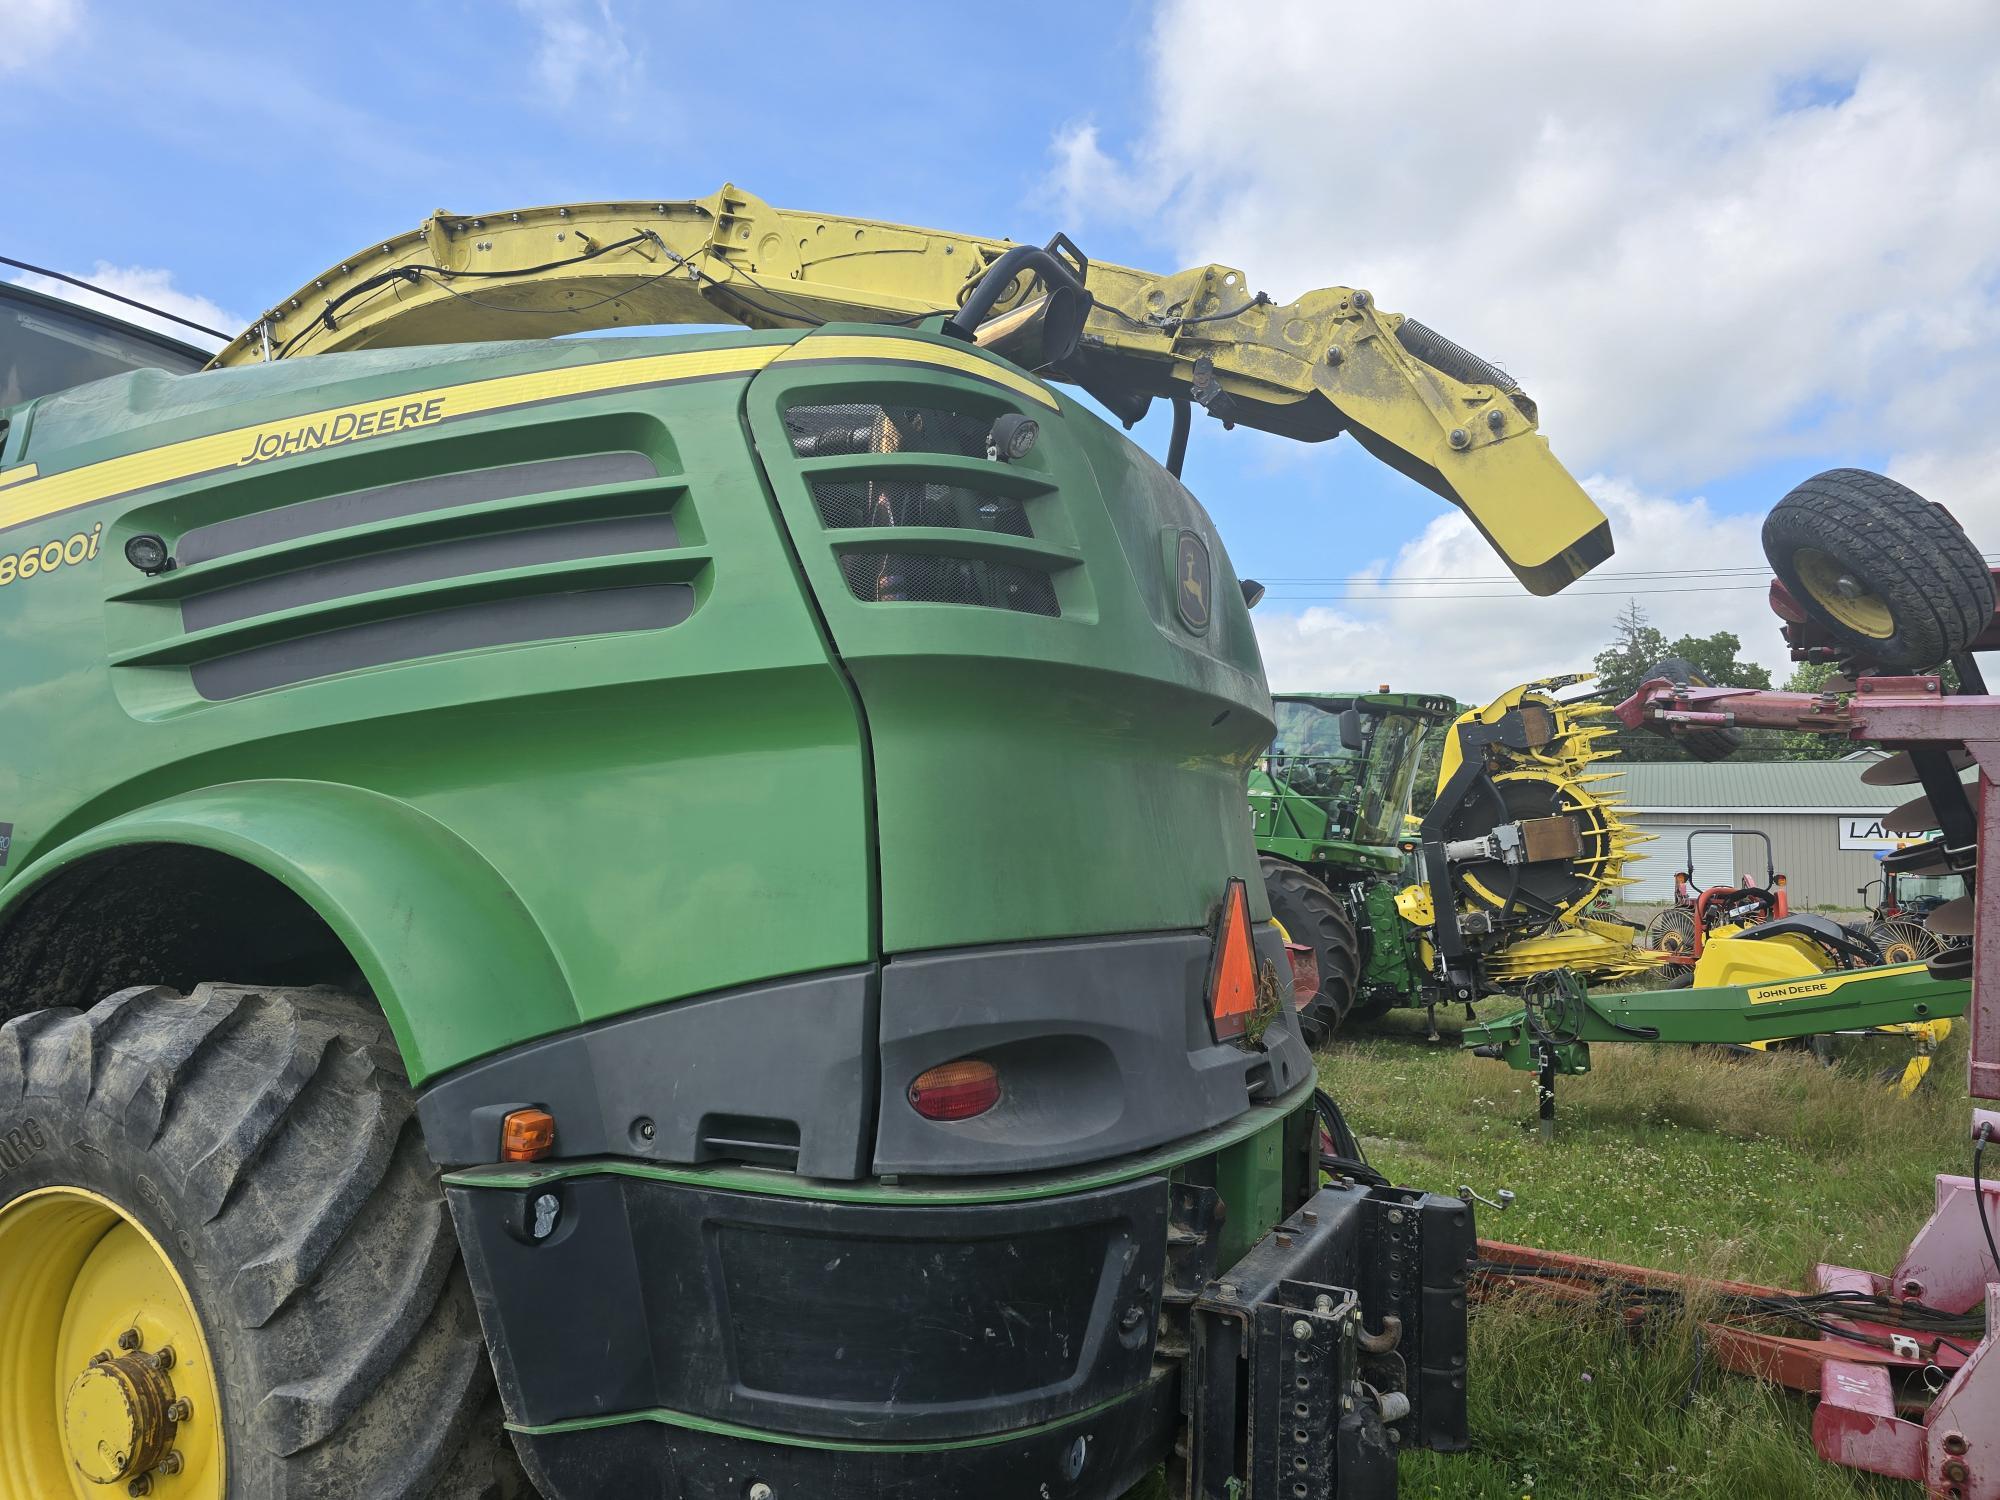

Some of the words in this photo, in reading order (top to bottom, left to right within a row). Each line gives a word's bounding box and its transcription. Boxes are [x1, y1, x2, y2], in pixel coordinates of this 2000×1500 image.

[241, 423, 328, 462] JOHN
[329, 397, 446, 442] DEERE
[0, 521, 103, 587] 8600i
[1757, 988, 1787, 999] JOHN
[1788, 983, 1828, 995] DEERE
